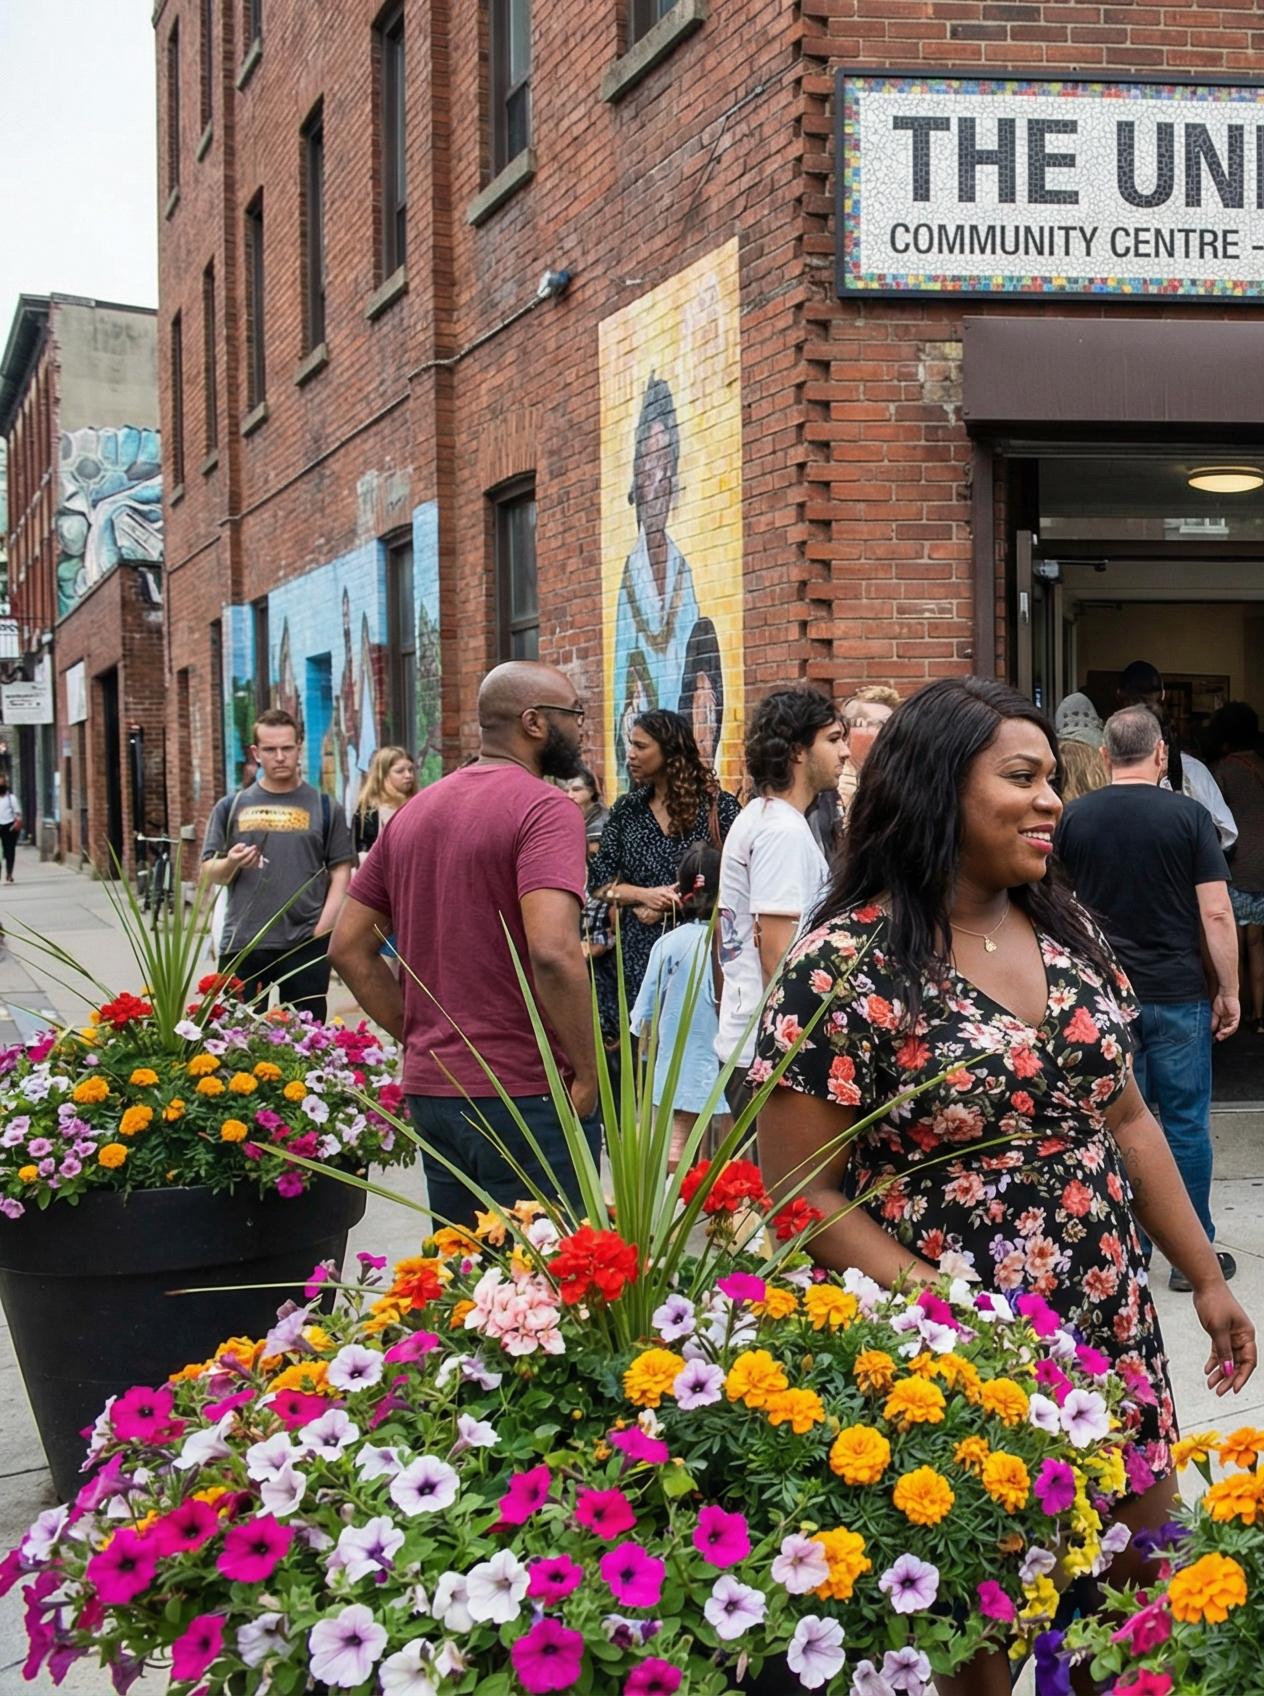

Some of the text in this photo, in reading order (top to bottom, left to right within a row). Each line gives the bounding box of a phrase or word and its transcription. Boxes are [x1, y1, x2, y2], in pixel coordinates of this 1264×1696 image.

[893, 116, 1079, 204] THE
[889, 223, 1098, 257] COMMUNITY
[1111, 227, 1240, 260] CENTRE
